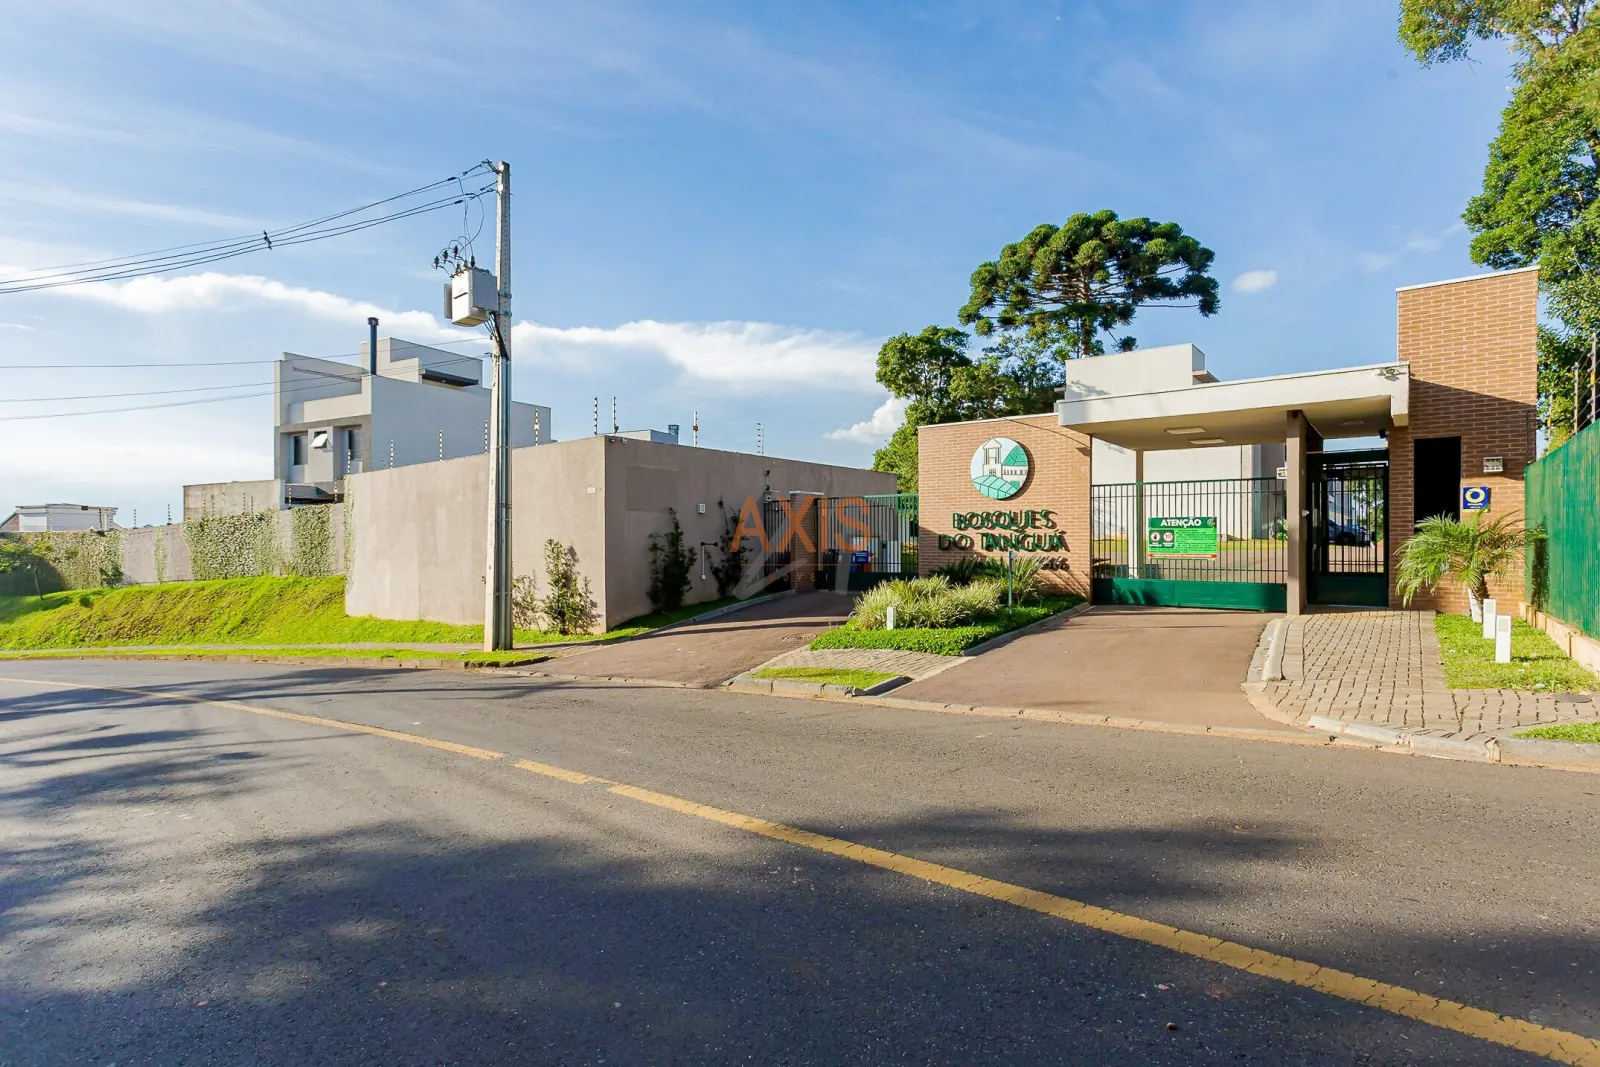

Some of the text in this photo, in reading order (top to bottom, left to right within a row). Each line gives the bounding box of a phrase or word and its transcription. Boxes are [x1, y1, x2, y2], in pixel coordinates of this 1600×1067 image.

[952, 509, 1049, 530] BOSQUES
[1161, 517, 1202, 528] ATENÇÃO
[938, 529, 1063, 551] DO TANGUÁ
